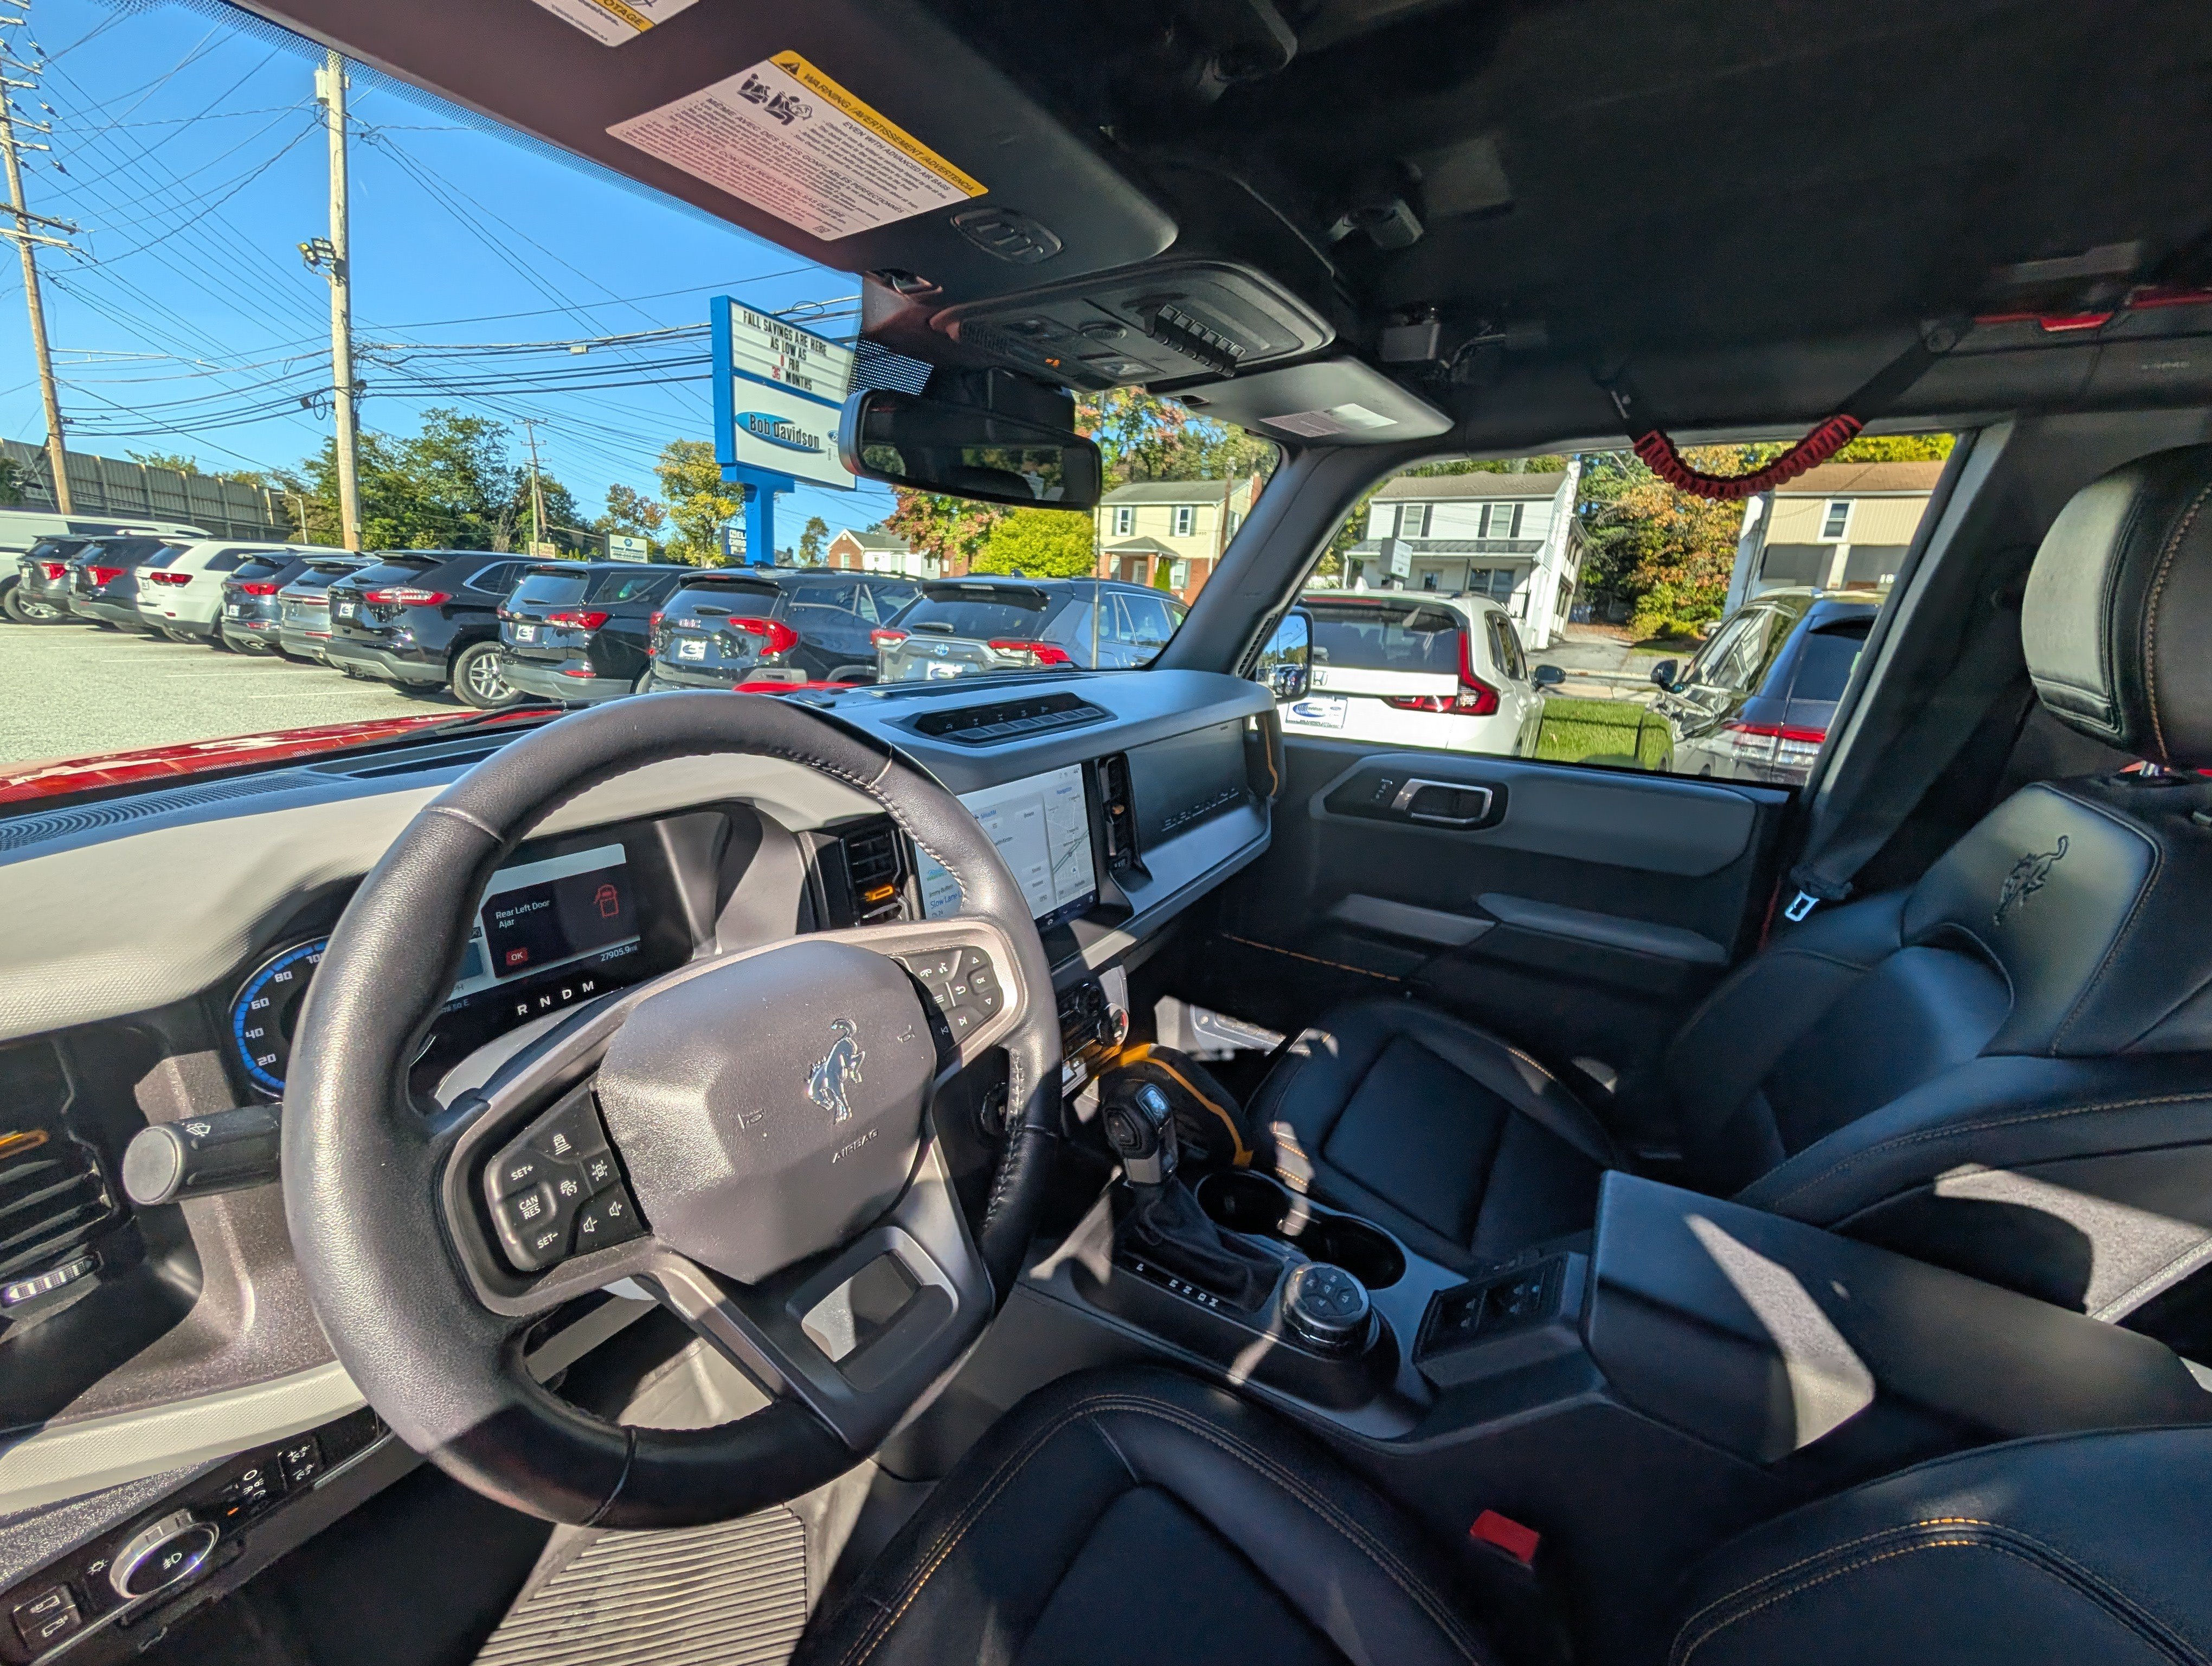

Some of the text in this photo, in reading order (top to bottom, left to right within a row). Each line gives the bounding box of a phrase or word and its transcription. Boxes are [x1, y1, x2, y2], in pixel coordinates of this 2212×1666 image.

[801, 74, 852, 108] WARNING
[736, 116, 762, 131] AVEC
[762, 130, 780, 142] DES
[780, 140, 803, 155] SACS
[844, 121, 949, 190] EVEN WITH ADVANCED AIR BAGS
[743, 310, 827, 357] FALL SAVINGS ARE HERE
[770, 337, 807, 361] AS LOW AS
[789, 358, 800, 372] FOR
[772, 366, 812, 390] 36 MONTHS
[750, 414, 770, 435] Bob
[773, 421, 820, 449] Davidson
[679, 619, 701, 629] GMC
[930, 899, 943, 909] Slow
[944, 893, 957, 902] Lane
[496, 900, 550, 919] Rear Left Door
[499, 919, 515, 928] Ajar
[306, 953, 323, 964] 10
[511, 953, 523, 962] OK
[274, 971, 293, 983] 80
[250, 997, 270, 1010] 60
[245, 1028, 264, 1039] 40
[257, 1054, 276, 1066] 20
[832, 1129, 878, 1163] AIRBAG
[511, 1165, 533, 1181] SET+
[519, 1195, 538, 1212] CAN
[524, 1205, 541, 1220] RES
